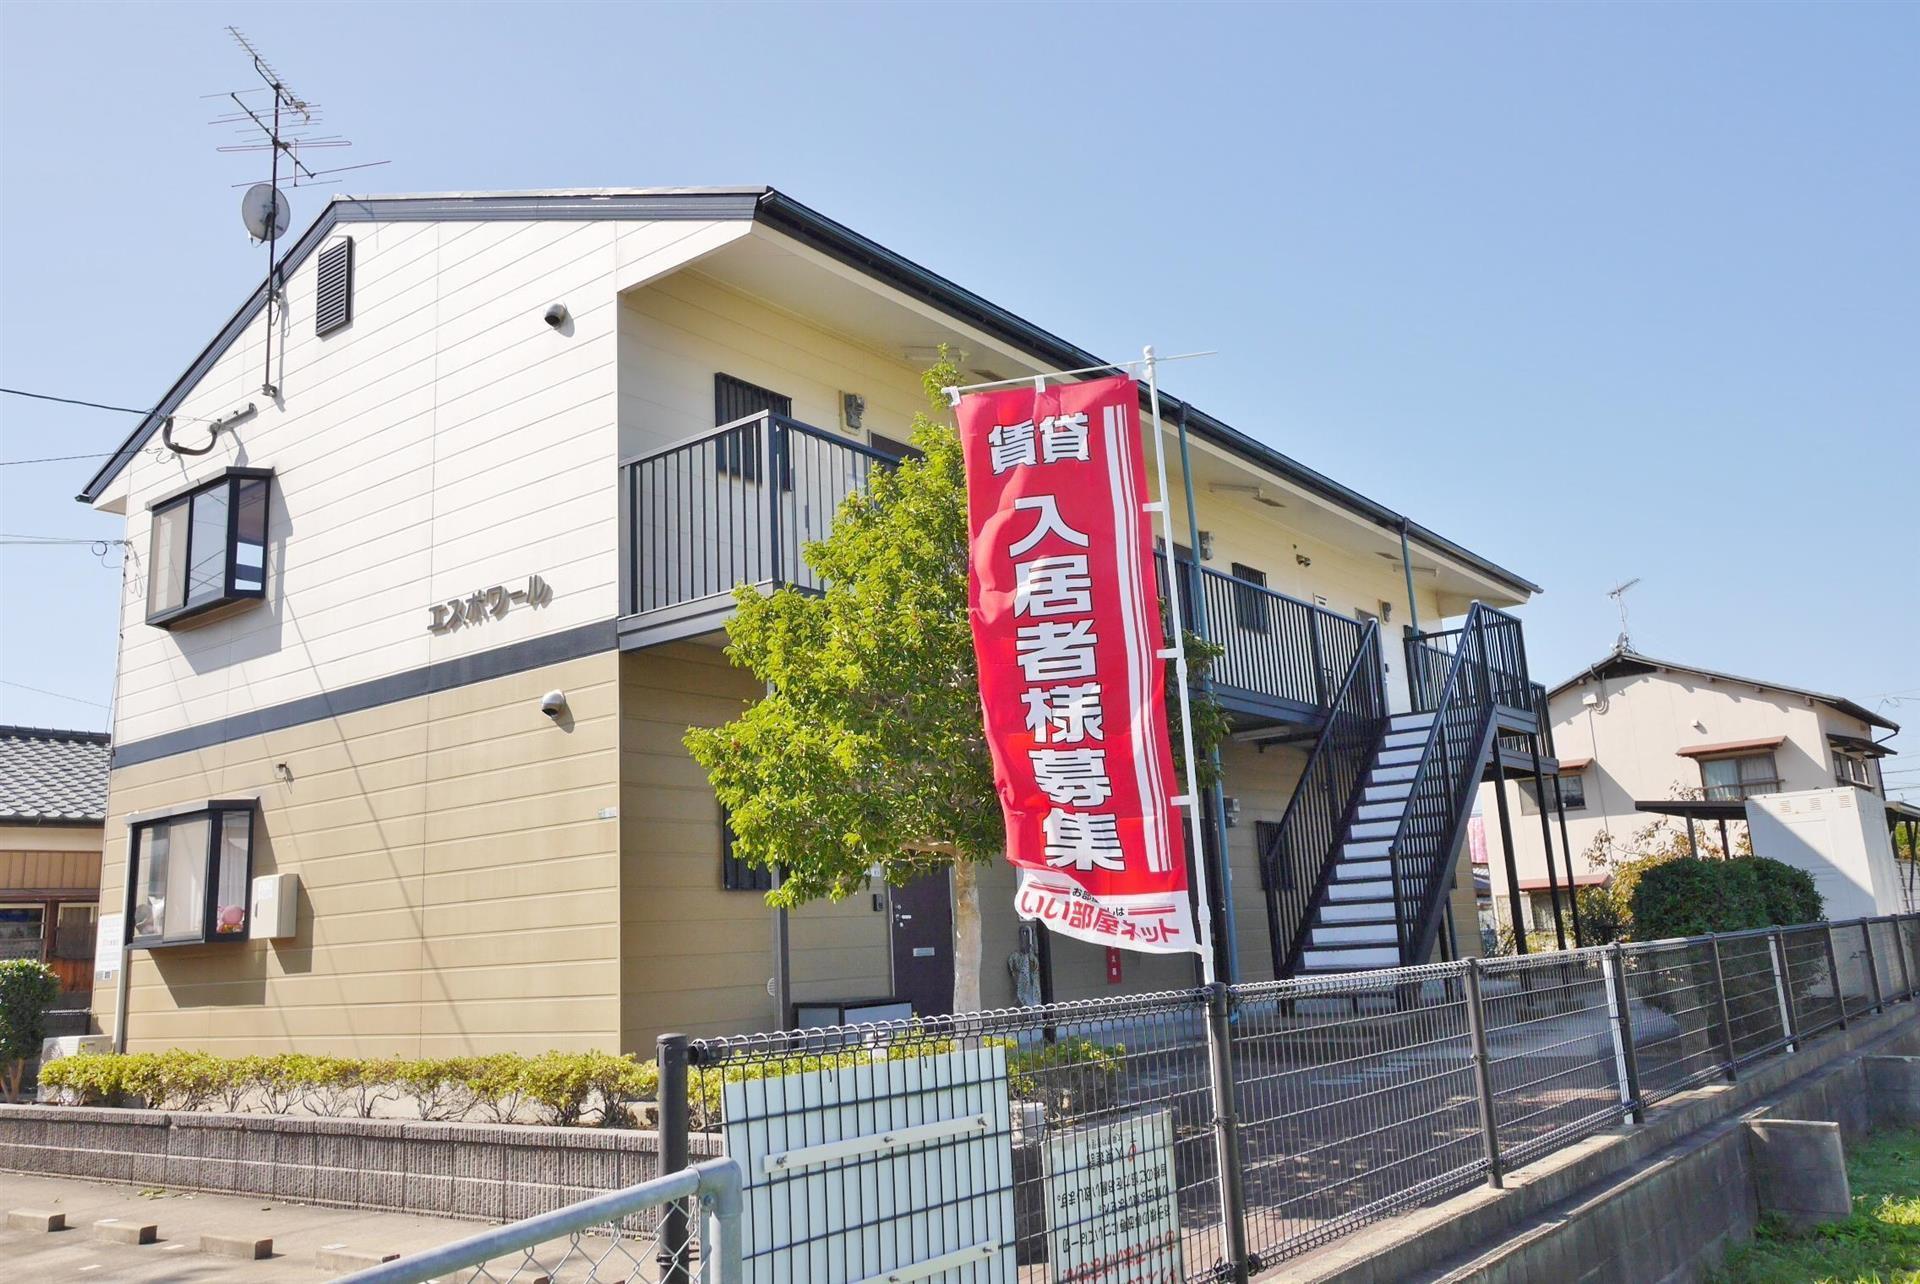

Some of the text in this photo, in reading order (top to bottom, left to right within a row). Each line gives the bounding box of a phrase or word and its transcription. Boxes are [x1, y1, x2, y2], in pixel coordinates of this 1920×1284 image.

[988, 412, 1091, 476] 賃貸
[427, 575, 553, 636] エスポワール
[1008, 494, 1126, 872] 入居者様募集
[1020, 890, 1180, 943] いい部屋ネット
